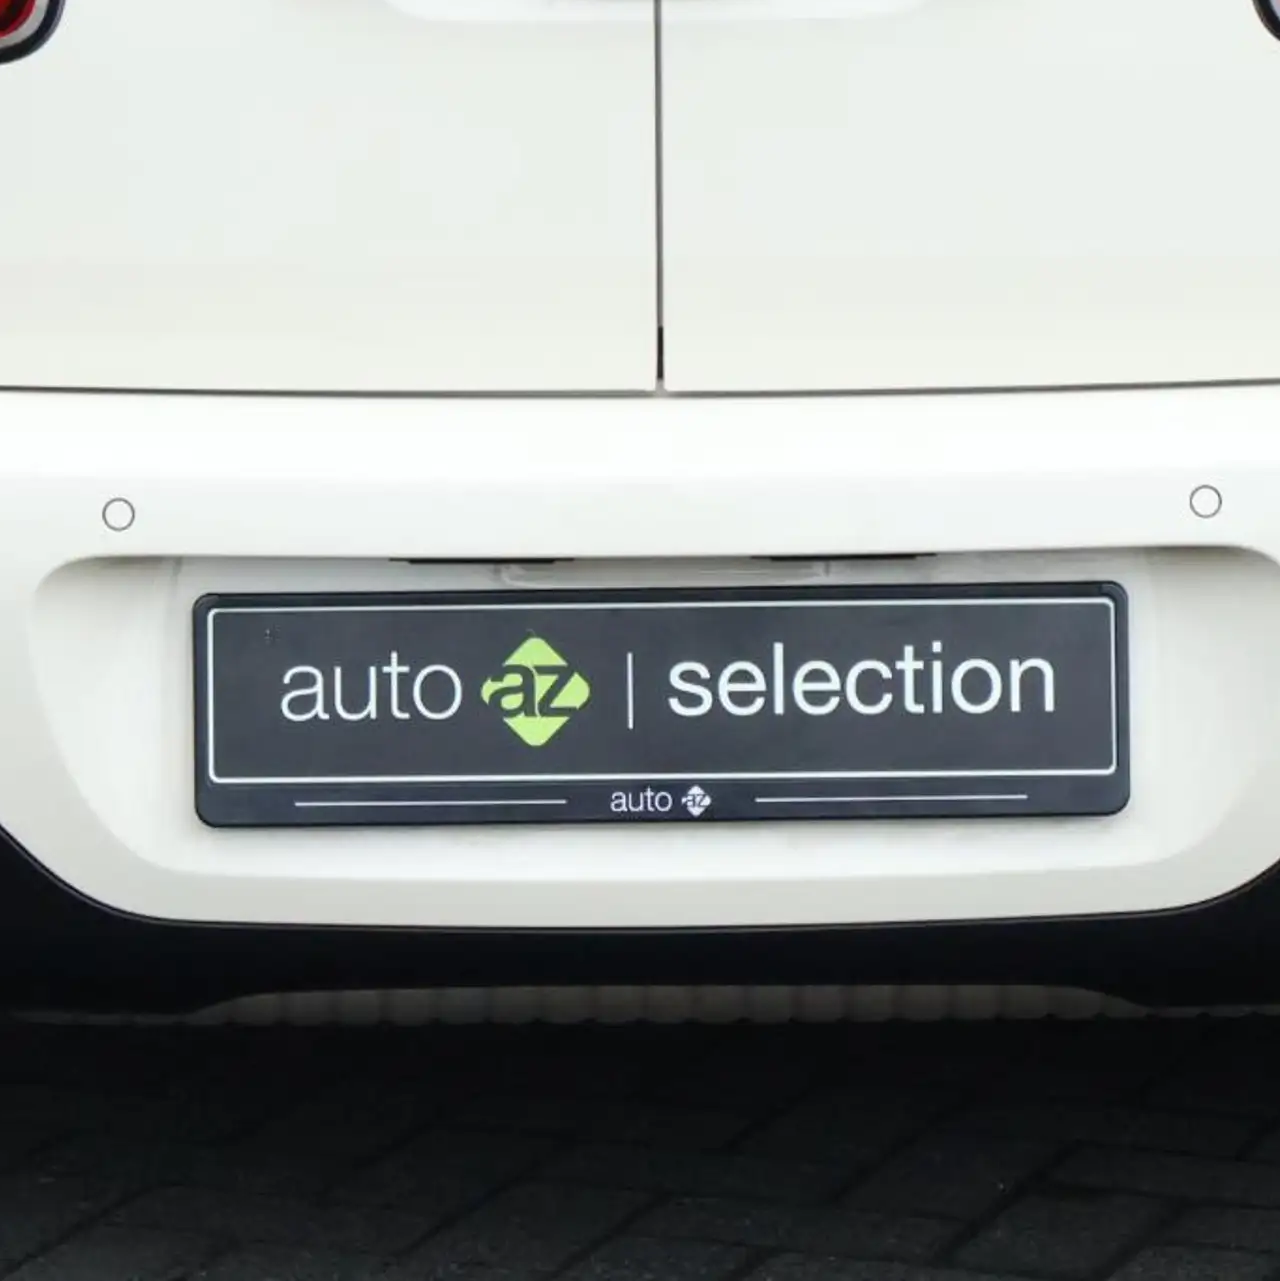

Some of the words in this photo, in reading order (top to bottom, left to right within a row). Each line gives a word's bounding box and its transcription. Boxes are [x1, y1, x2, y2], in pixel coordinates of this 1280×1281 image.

[280, 650, 463, 721] auto
[486, 663, 581, 719] az
[667, 641, 1056, 717] selection
[610, 785, 673, 812] auto
